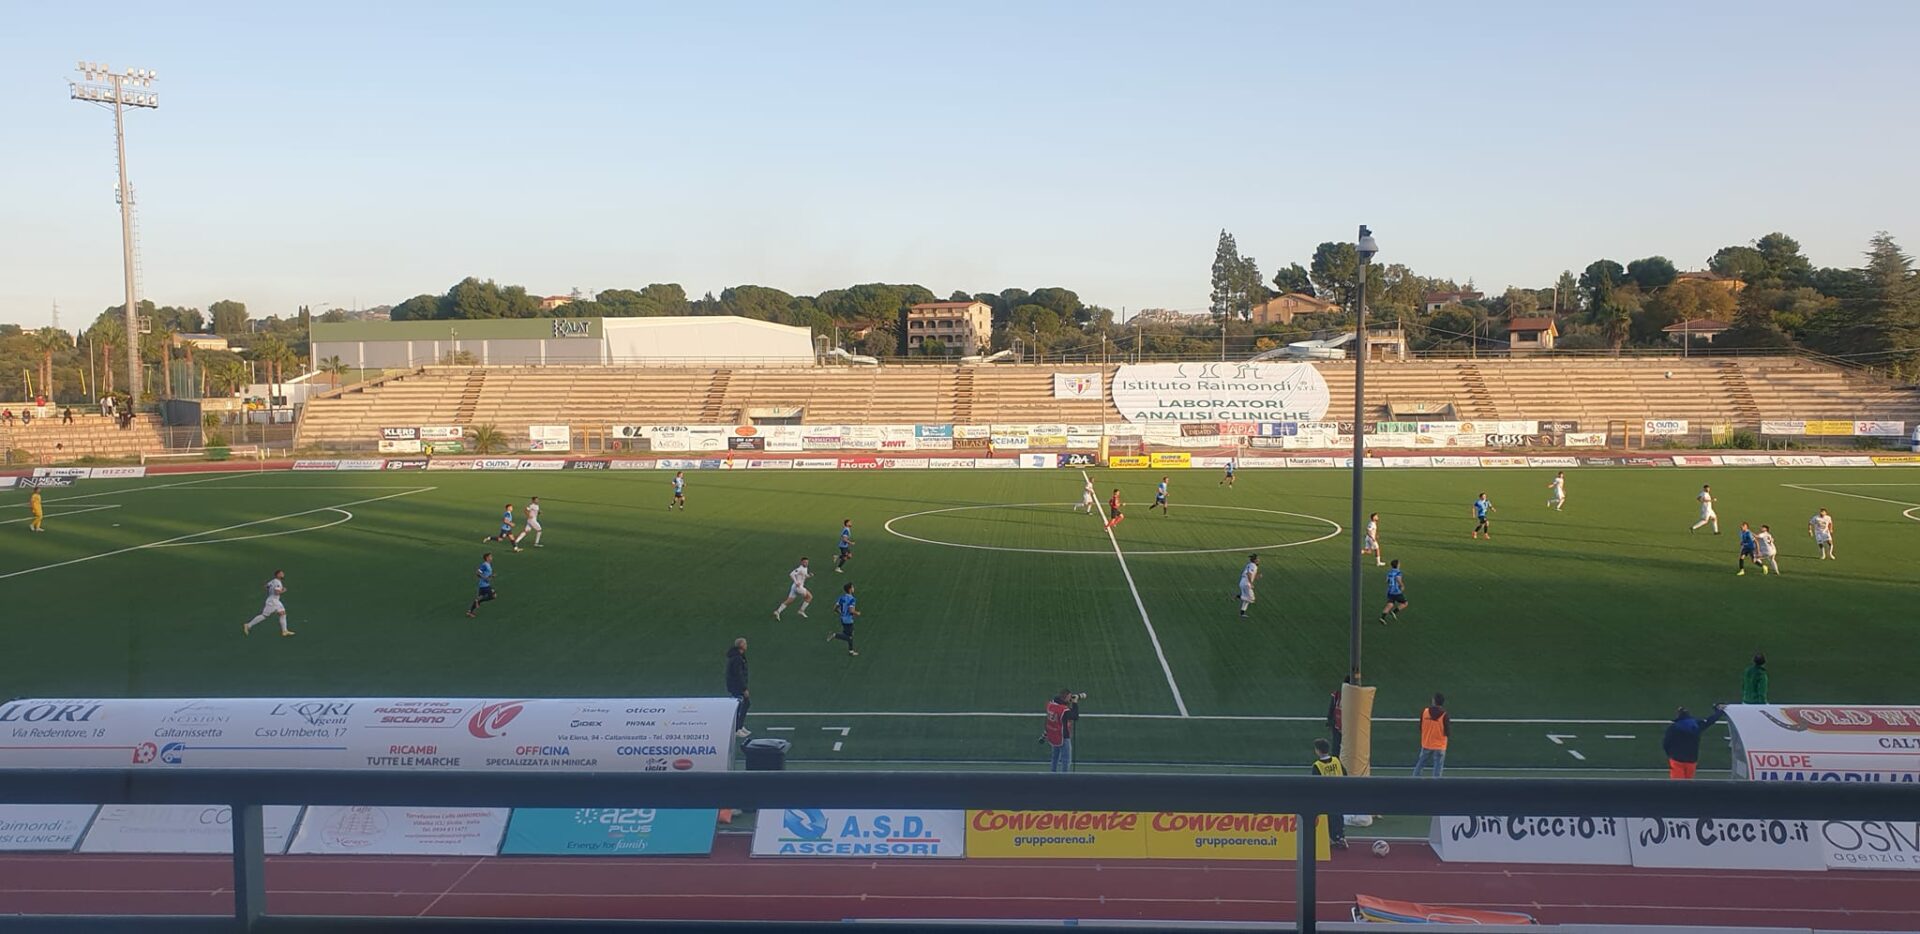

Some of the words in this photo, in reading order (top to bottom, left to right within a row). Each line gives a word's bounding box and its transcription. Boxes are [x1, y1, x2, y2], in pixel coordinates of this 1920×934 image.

[1123, 380, 1191, 391] Istituto
[1197, 380, 1291, 391] Raimondi
[1159, 400, 1284, 409] LABORATORI
[1135, 411, 1214, 421] ANALISI
[1218, 411, 1311, 422] CLINICHE
[0, 704, 104, 722] LORI
[626, 705, 666, 713] oticon
[12, 728, 27, 738] Via
[29, 728, 88, 739] Redentore,
[92, 728, 106, 738] 18
[154, 728, 223, 738] Caltanissetta
[279, 728, 330, 739] Umberto,
[335, 728, 348, 738] 17
[389, 746, 437, 755] RICAMBI
[515, 746, 571, 756] OFFICINA
[617, 746, 718, 756] CONCESSIONARIA
[367, 757, 399, 767] TUTTE
[400, 757, 414, 767] LE
[415, 757, 461, 767] MARCHE
[486, 759, 549, 768] SPECIALIZZATA
[550, 759, 560, 768] IN
[561, 759, 599, 768] MINICAR
[1754, 754, 1813, 768] VOLPE
[840, 815, 932, 838] A.S.D.
[973, 810, 1138, 832] Conveniente
[608, 825, 653, 833] PLUS
[1014, 834, 1096, 847] gruppoarena.it
[1195, 835, 1278, 848] gruppoarena.it
[780, 843, 938, 855] ASCENSORI
[1834, 853, 1906, 864] agenzia
